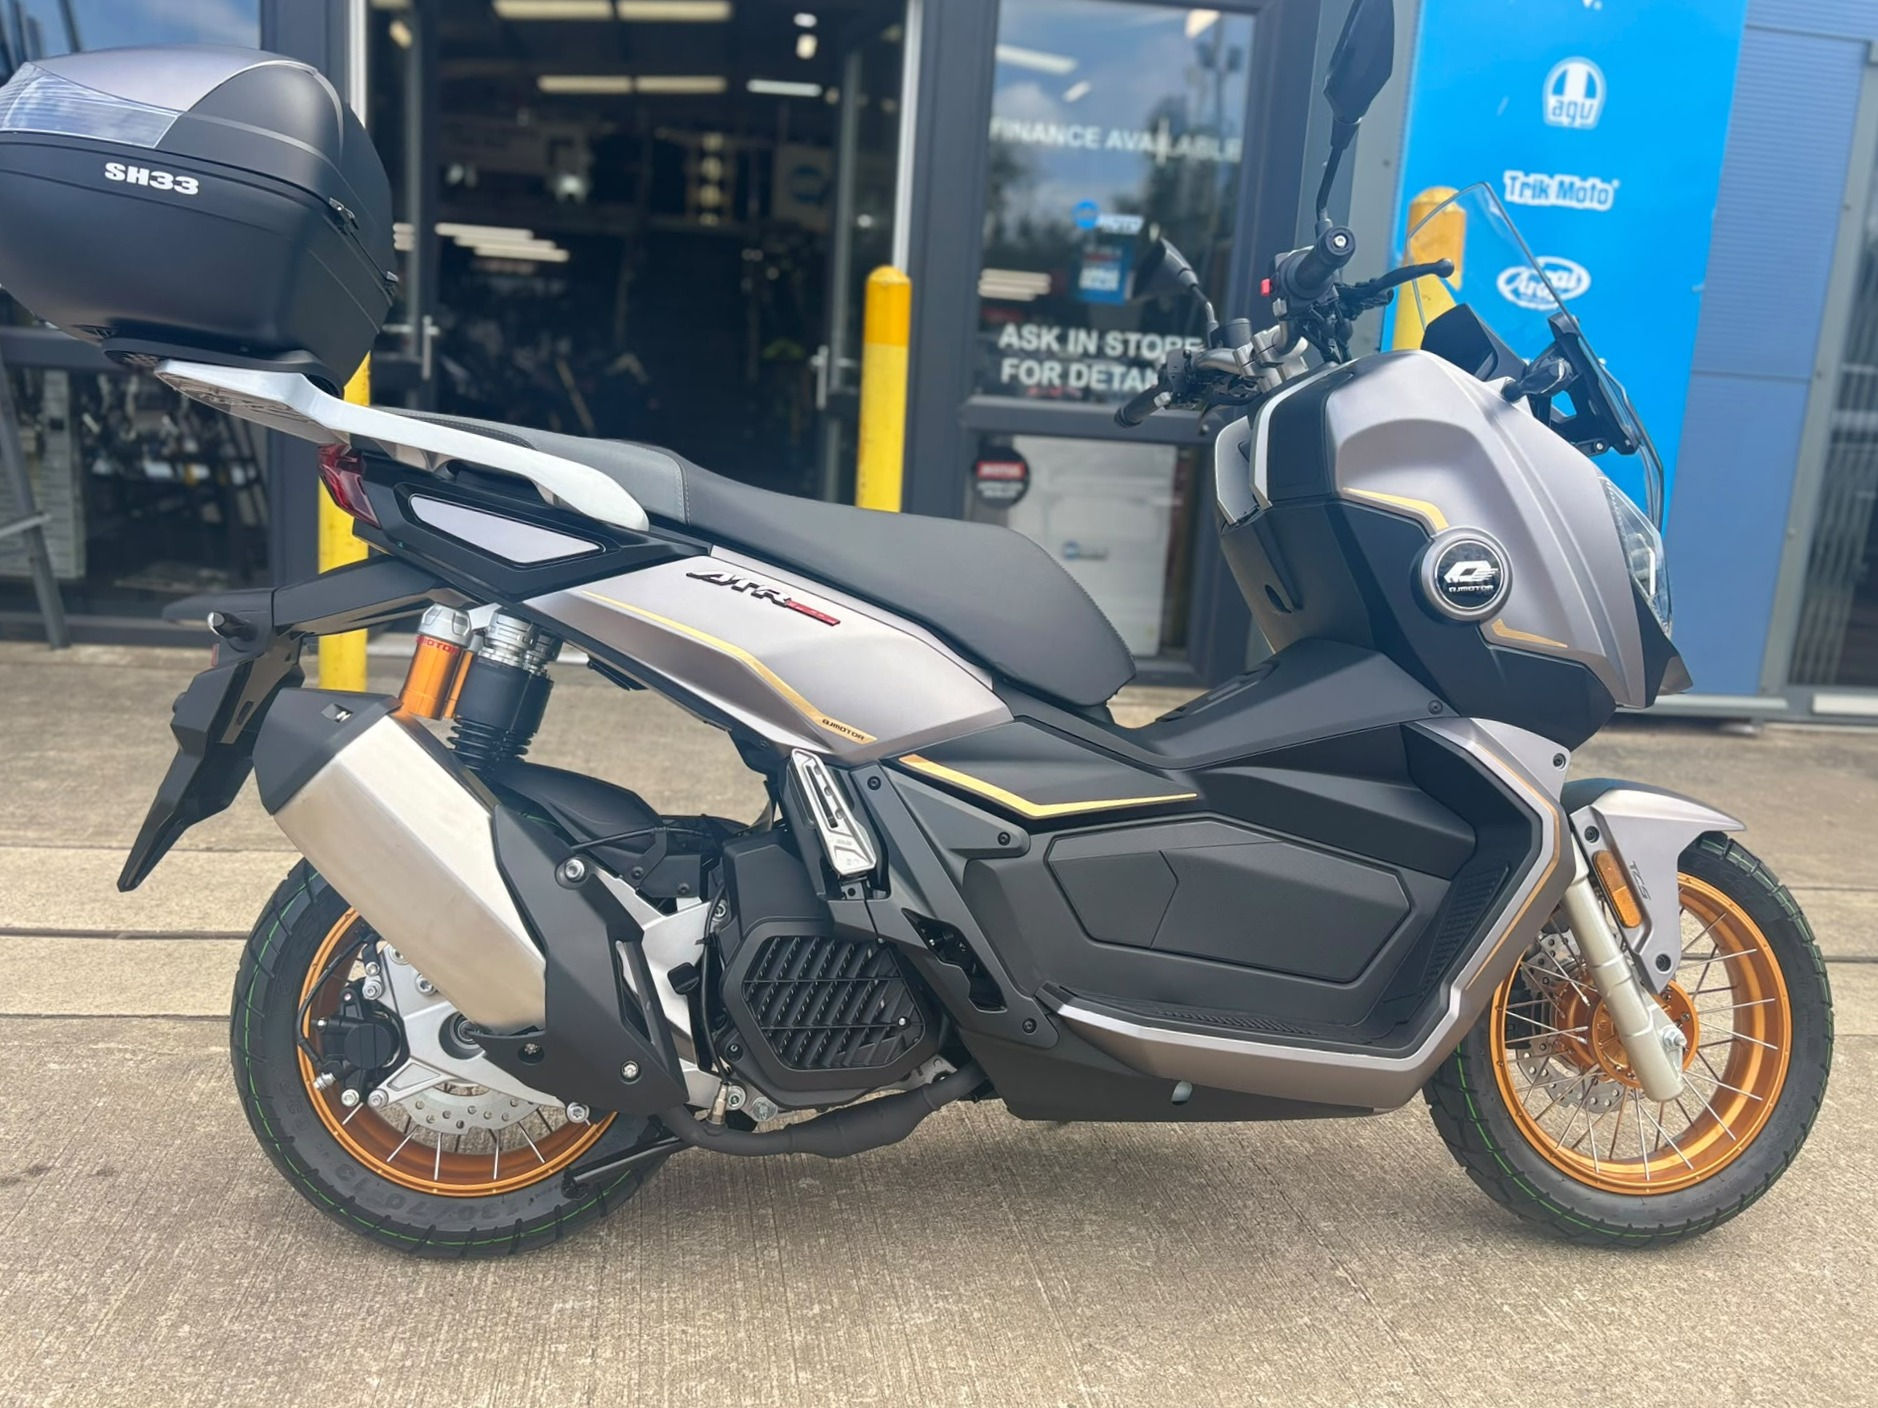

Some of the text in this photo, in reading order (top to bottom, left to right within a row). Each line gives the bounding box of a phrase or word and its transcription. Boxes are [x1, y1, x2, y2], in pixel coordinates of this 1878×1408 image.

[1551, 99, 1595, 125] agv
[989, 116, 1100, 150] FINANCE
[104, 162, 199, 195] SH33
[1505, 172, 1552, 204] Trik
[999, 322, 1061, 352] ASK
[1067, 327, 1100, 356] IN
[1001, 357, 1063, 388] FOR
[1630, 860, 1652, 901] TCS
